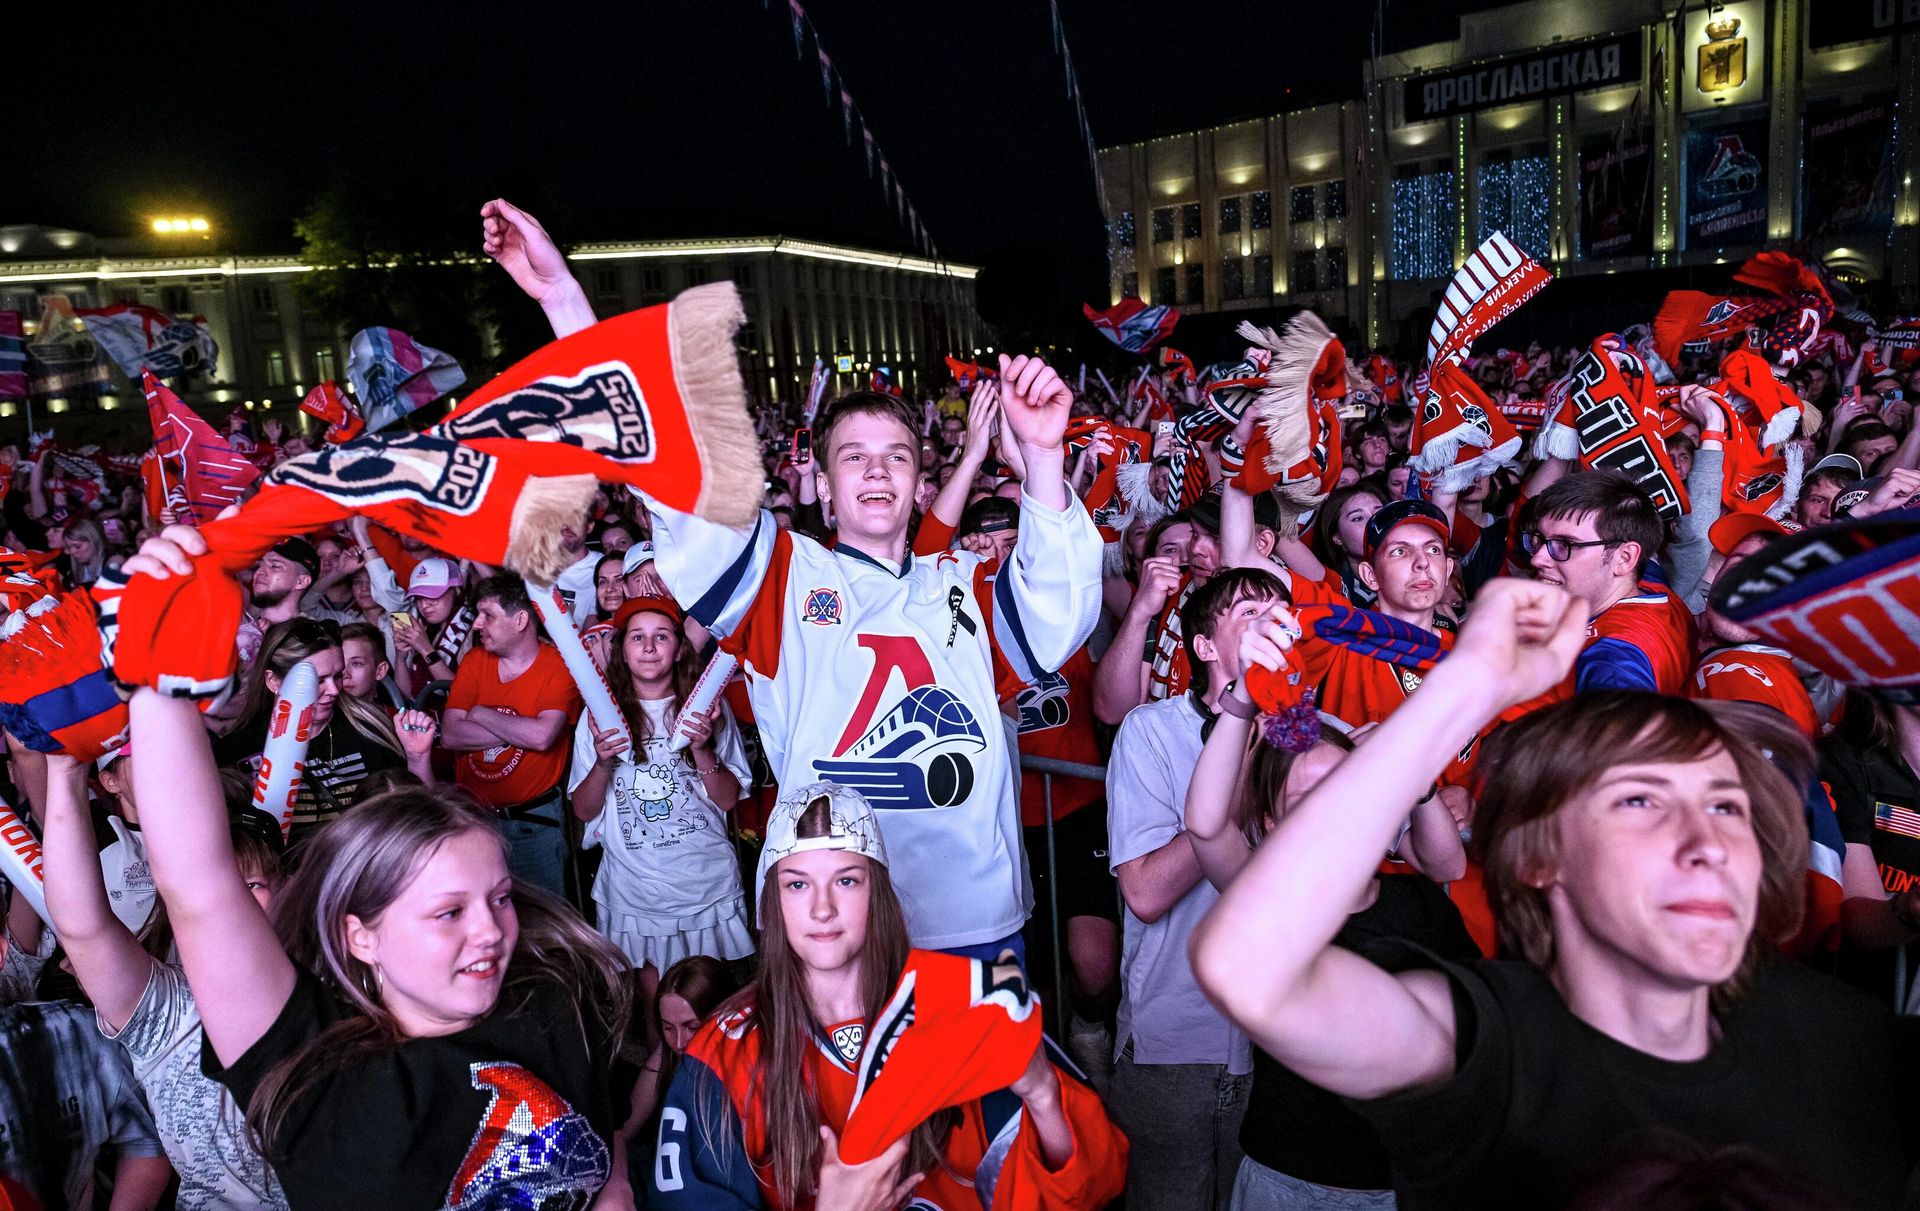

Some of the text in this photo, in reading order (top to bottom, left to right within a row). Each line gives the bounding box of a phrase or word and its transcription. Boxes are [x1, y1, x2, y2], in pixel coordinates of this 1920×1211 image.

[1423, 43, 1621, 114] ЯРОСЛАВСКАЯ
[597, 374, 648, 455] 2025
[437, 446, 485, 507] 202
[809, 606, 836, 617] ФХМ
[502, 748, 524, 776] TUDIES
